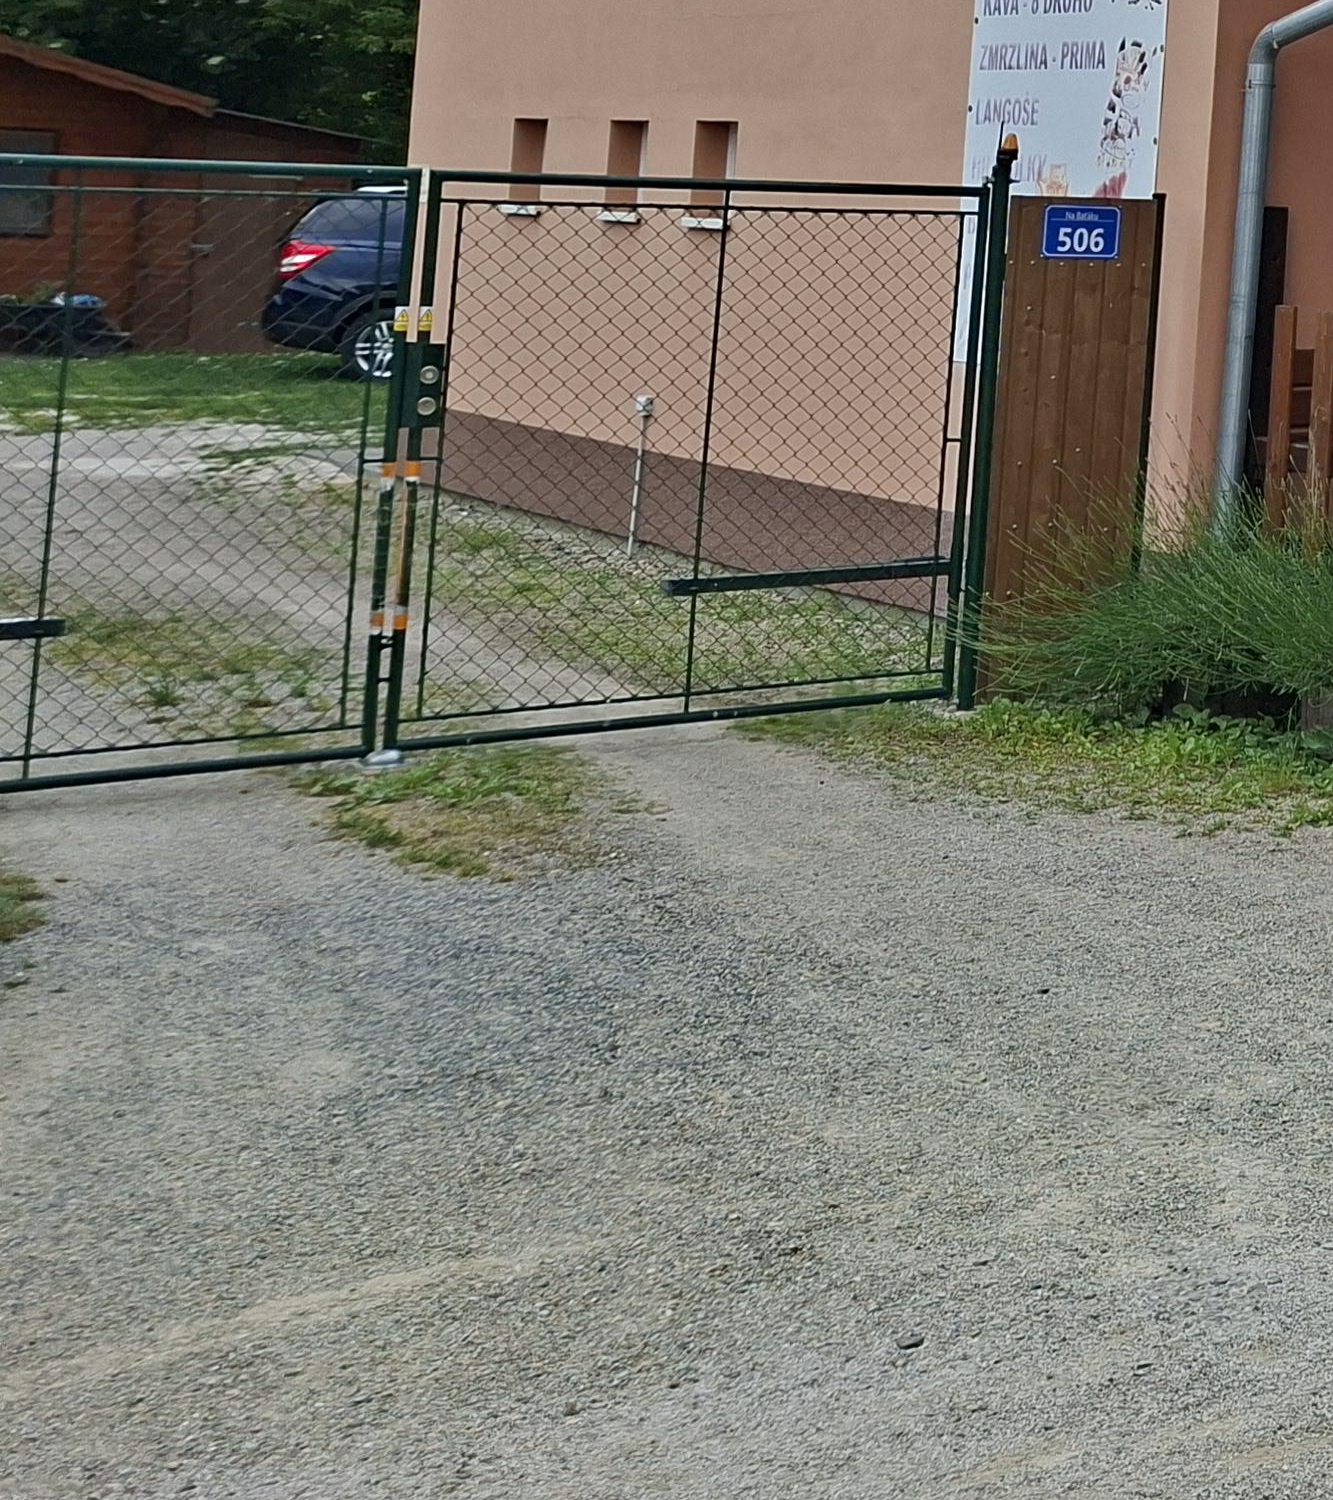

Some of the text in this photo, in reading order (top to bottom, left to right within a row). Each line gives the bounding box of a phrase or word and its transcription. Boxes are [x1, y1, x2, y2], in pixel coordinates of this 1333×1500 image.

[979, 43, 1048, 71] ZMRZLINA
[1060, 40, 1106, 70] PRIMA
[1056, 227, 1104, 253] 506
